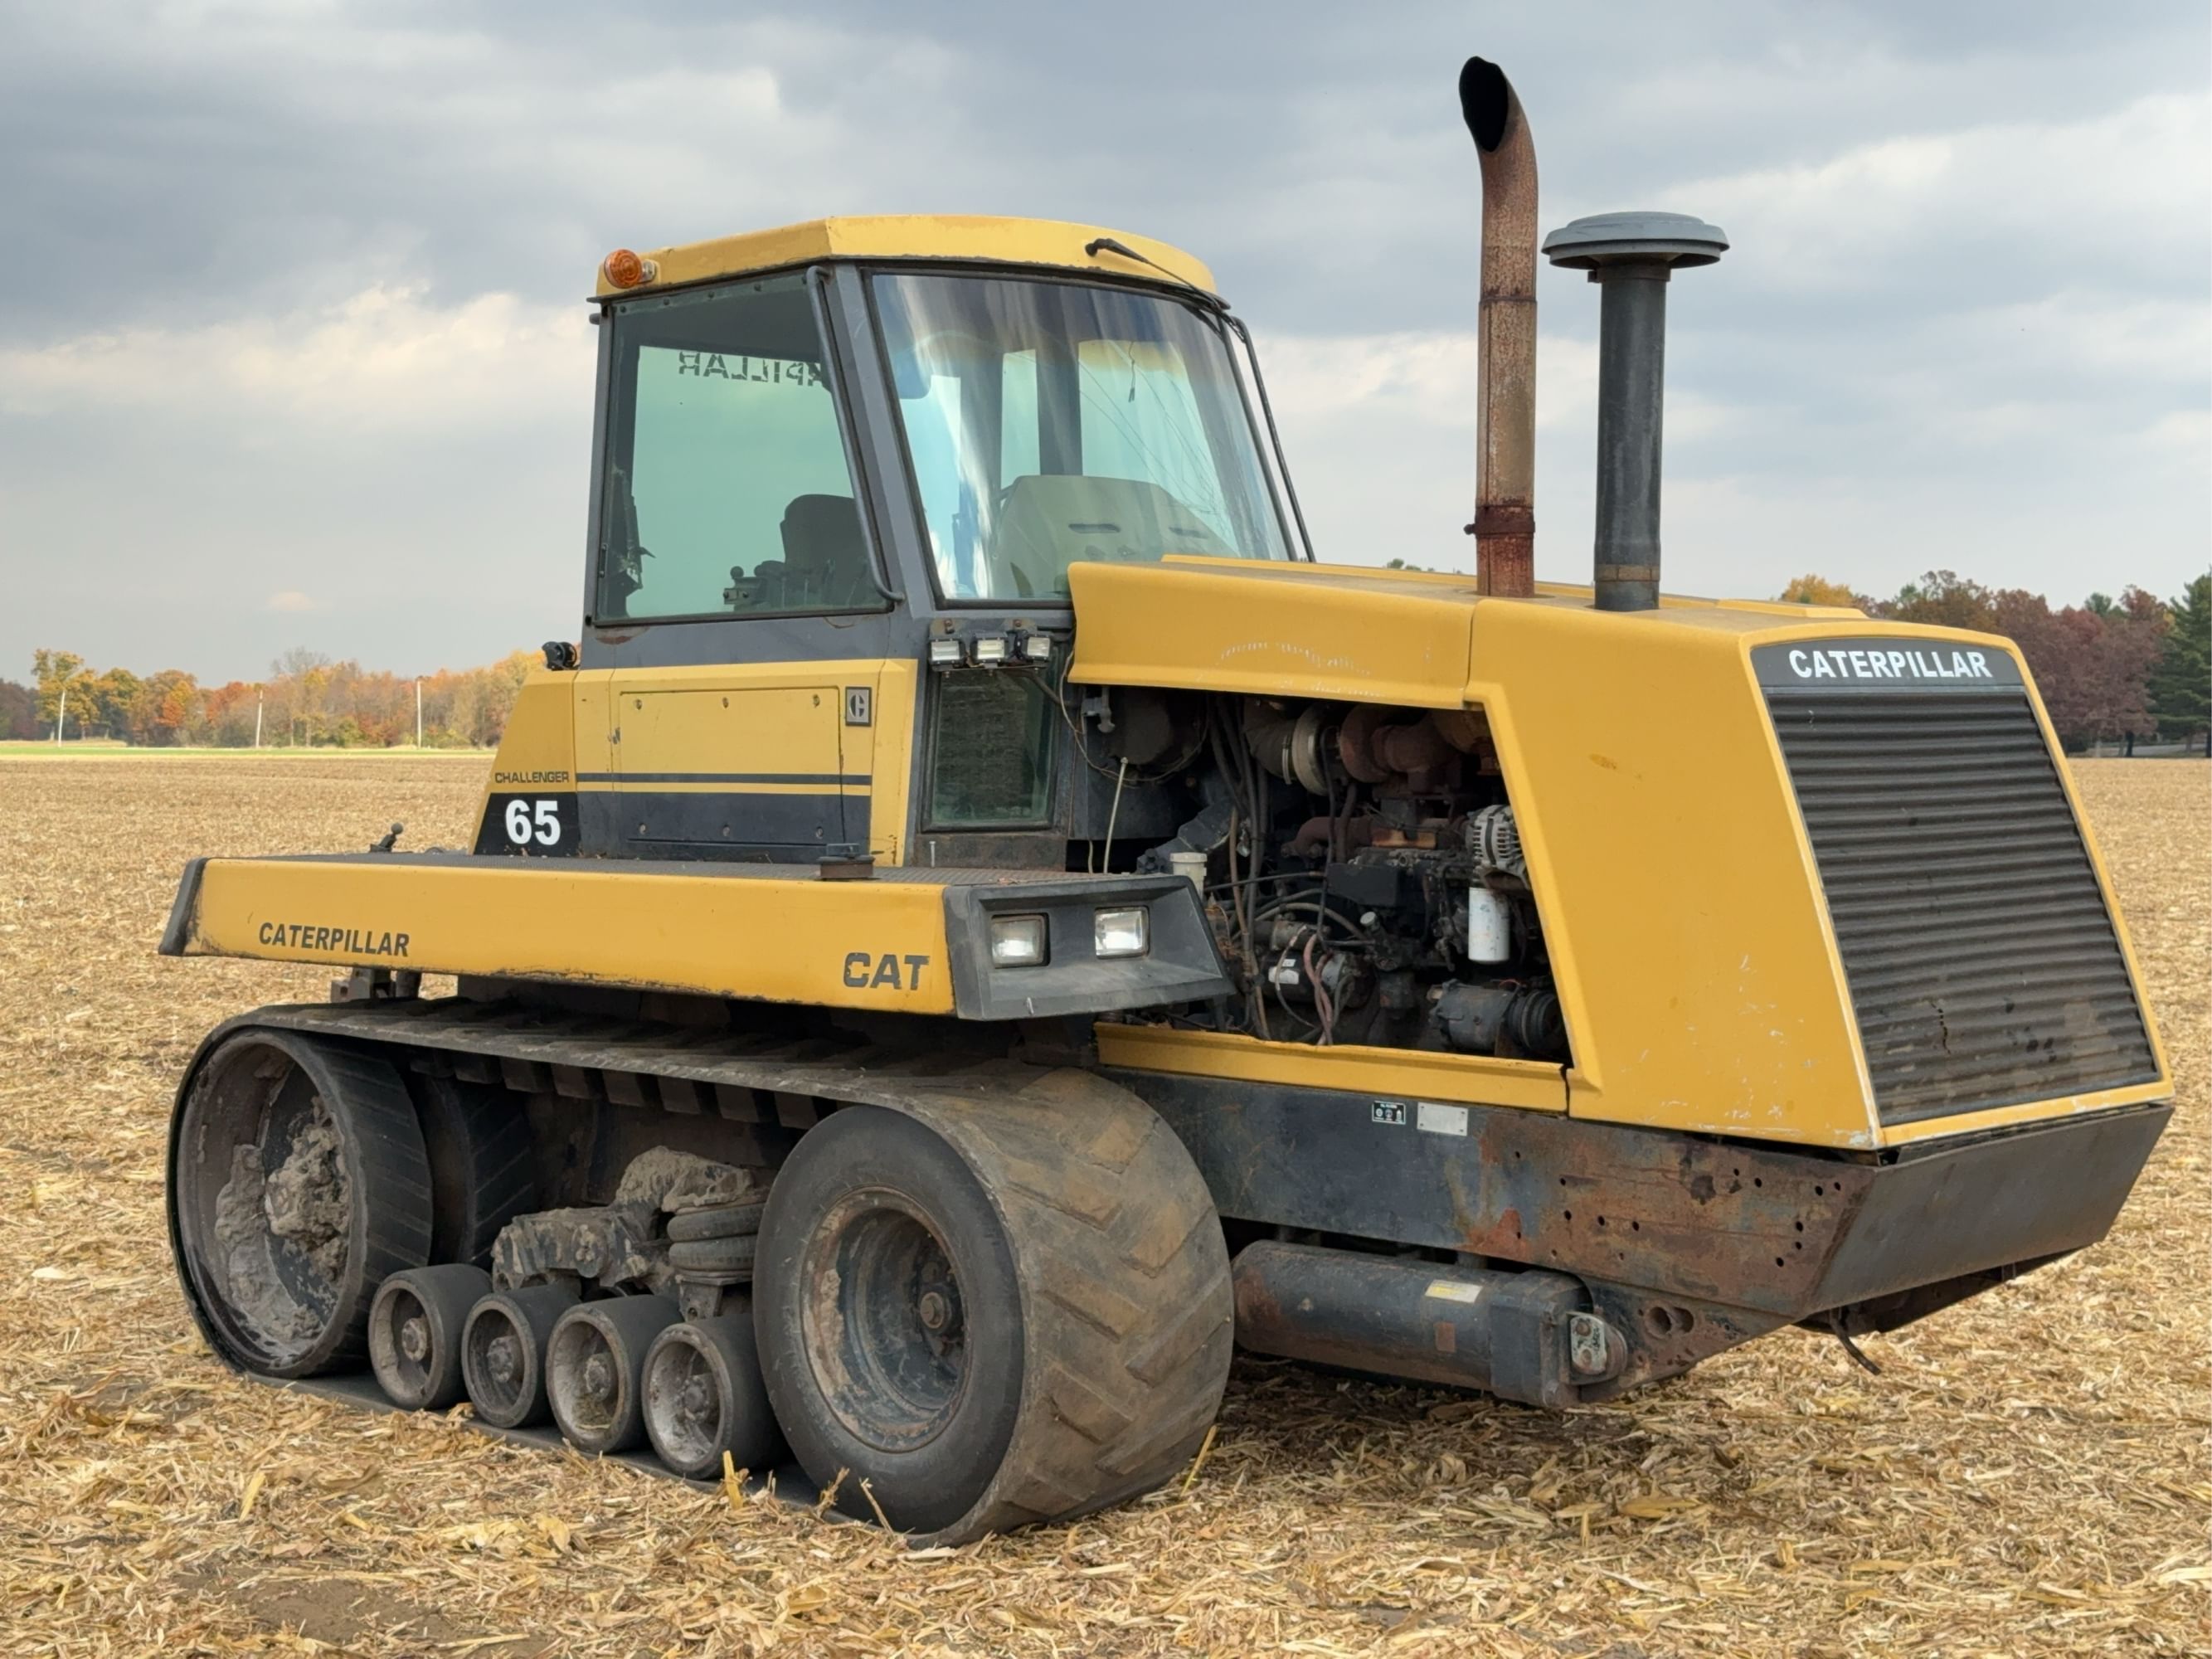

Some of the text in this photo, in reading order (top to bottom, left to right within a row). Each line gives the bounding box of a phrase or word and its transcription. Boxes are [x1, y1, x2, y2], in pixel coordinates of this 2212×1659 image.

[1788, 649, 1993, 679] CATERPILLAR
[494, 771, 570, 784] CHALLENGER
[505, 799, 561, 846] 65
[259, 922, 410, 957] CATERPILLAR
[843, 951, 931, 990] CAT
